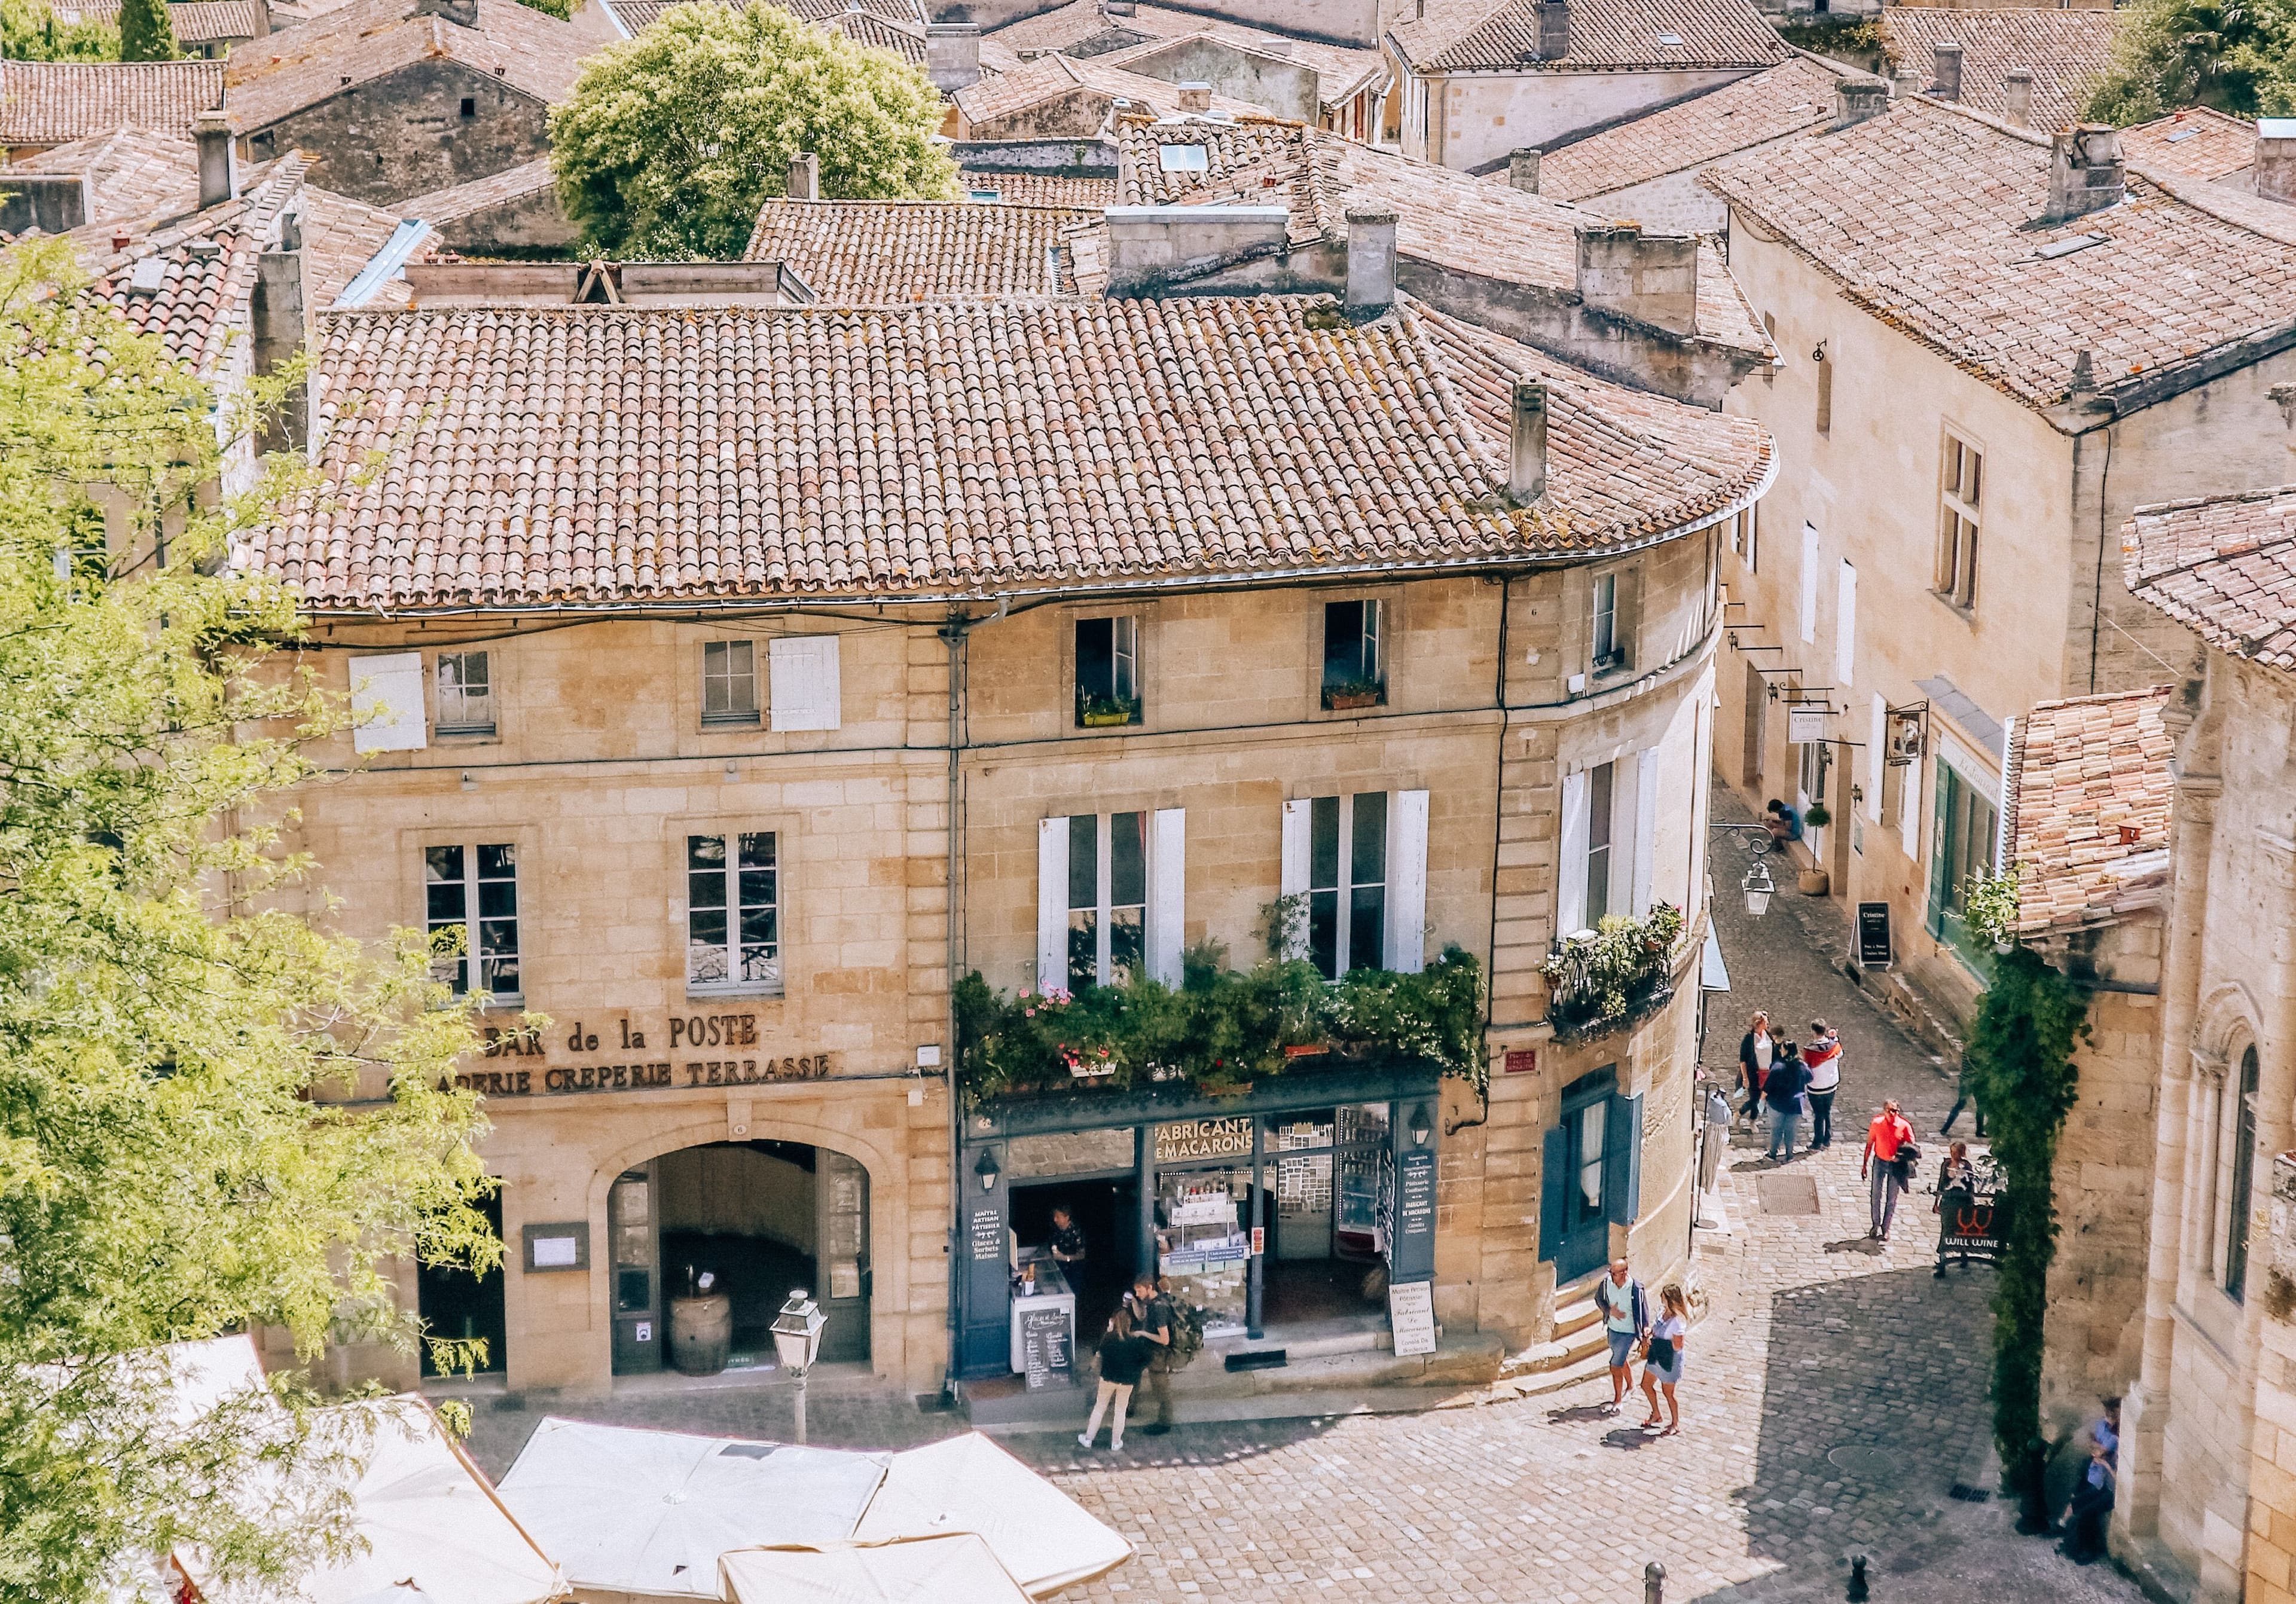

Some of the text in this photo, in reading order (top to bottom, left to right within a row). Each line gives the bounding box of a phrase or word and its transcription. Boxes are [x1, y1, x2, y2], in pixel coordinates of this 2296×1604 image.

[484, 1015, 756, 1058] BAR de la POSTE
[545, 1063, 671, 1090] CREPERIE
[686, 1055, 829, 1084] TERRASSE
[1155, 1135, 1253, 1159] E MACARONS
[1408, 1208, 1431, 1216] MACARONS
[1945, 1238, 1999, 1248] WILL WINE
